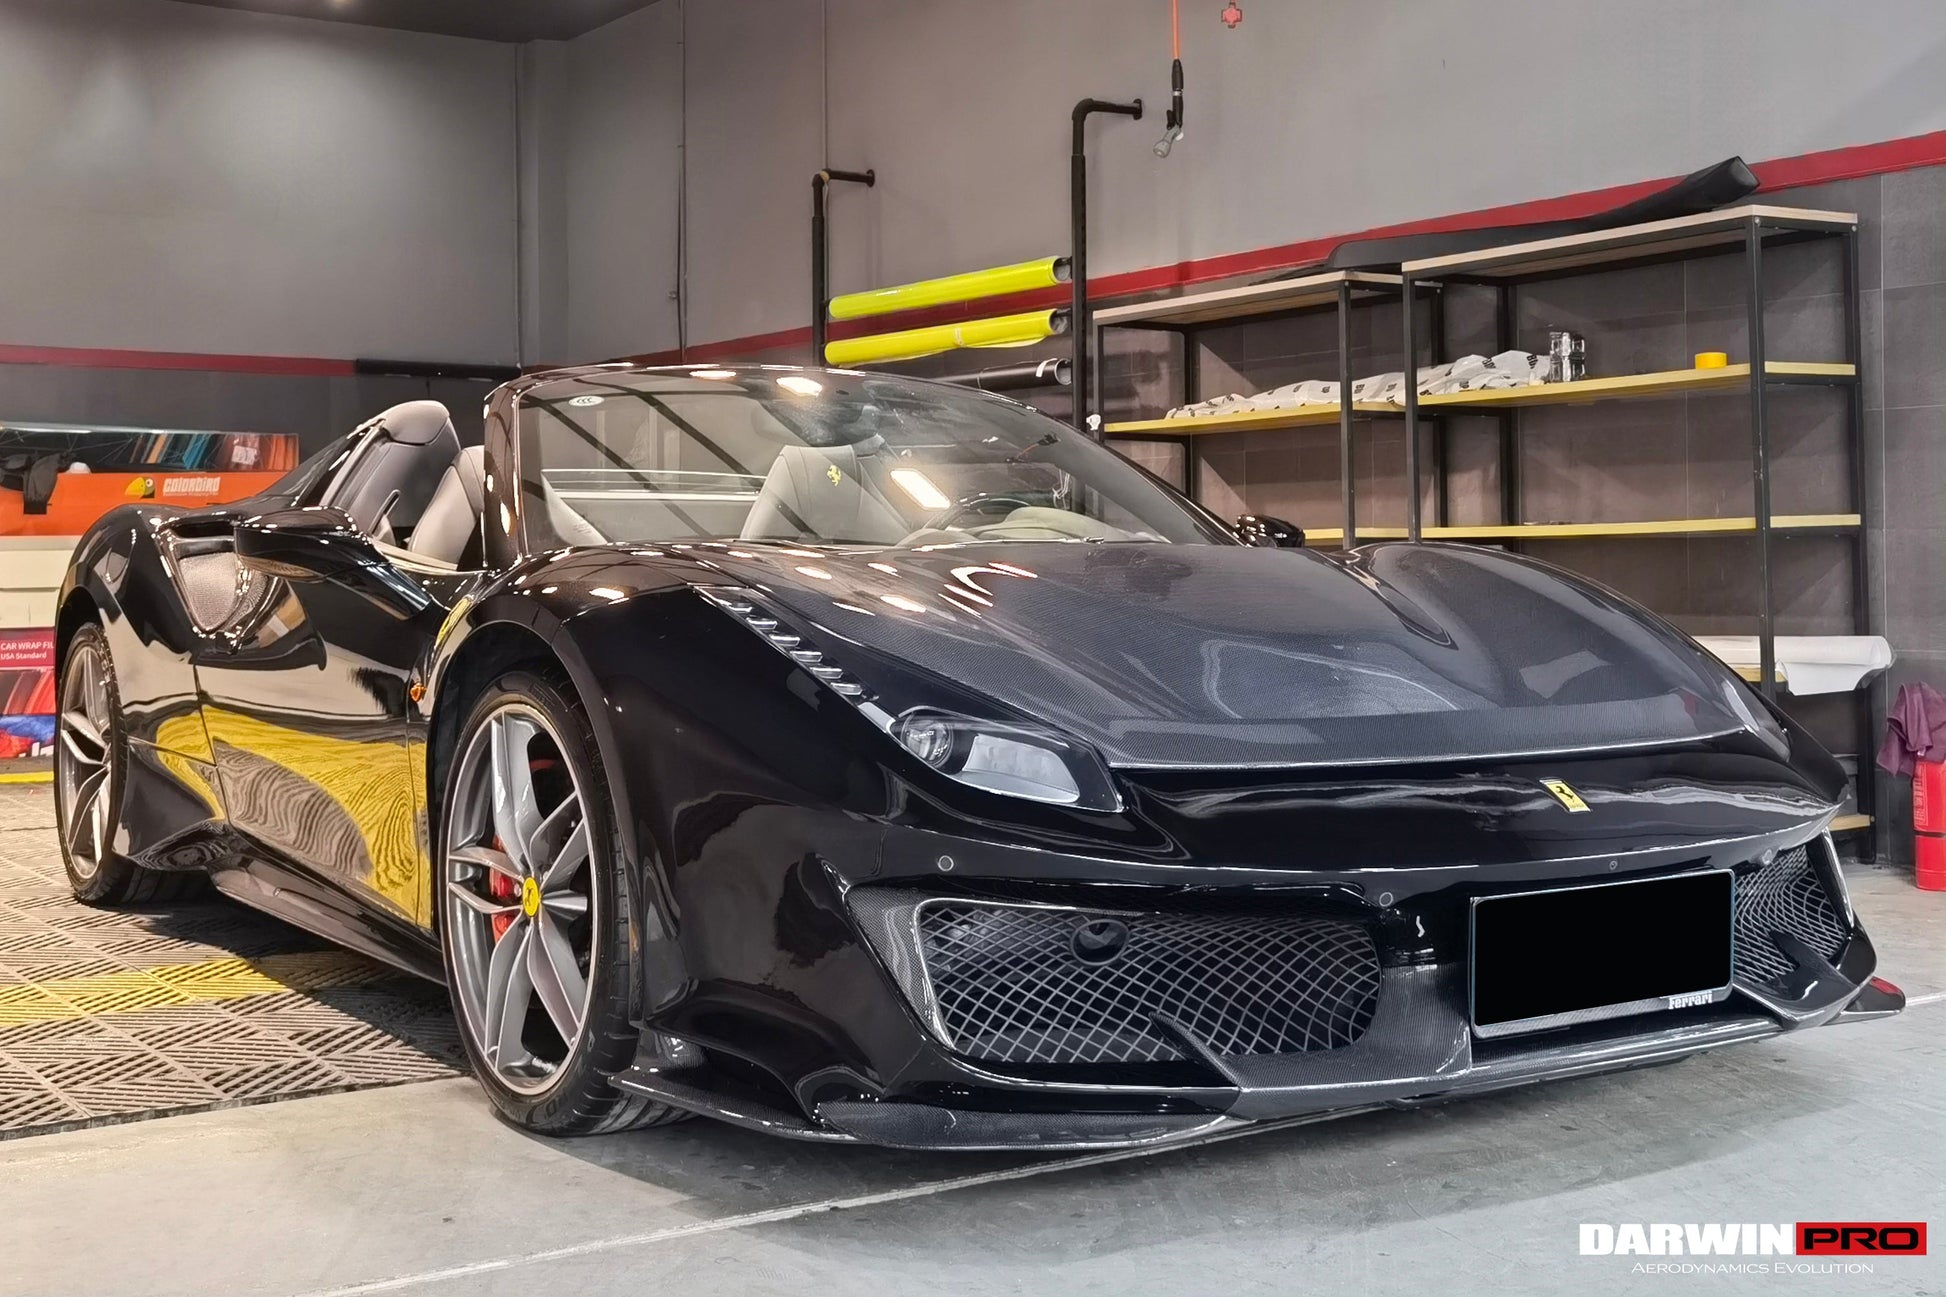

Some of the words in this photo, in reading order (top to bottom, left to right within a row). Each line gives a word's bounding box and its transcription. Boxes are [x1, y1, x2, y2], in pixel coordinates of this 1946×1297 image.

[0, 642, 17, 650] CAR
[18, 641, 42, 650] WRAP
[43, 641, 54, 649] FIL
[16, 651, 47, 659] Standard
[1668, 990, 1712, 1010] Ferrari
